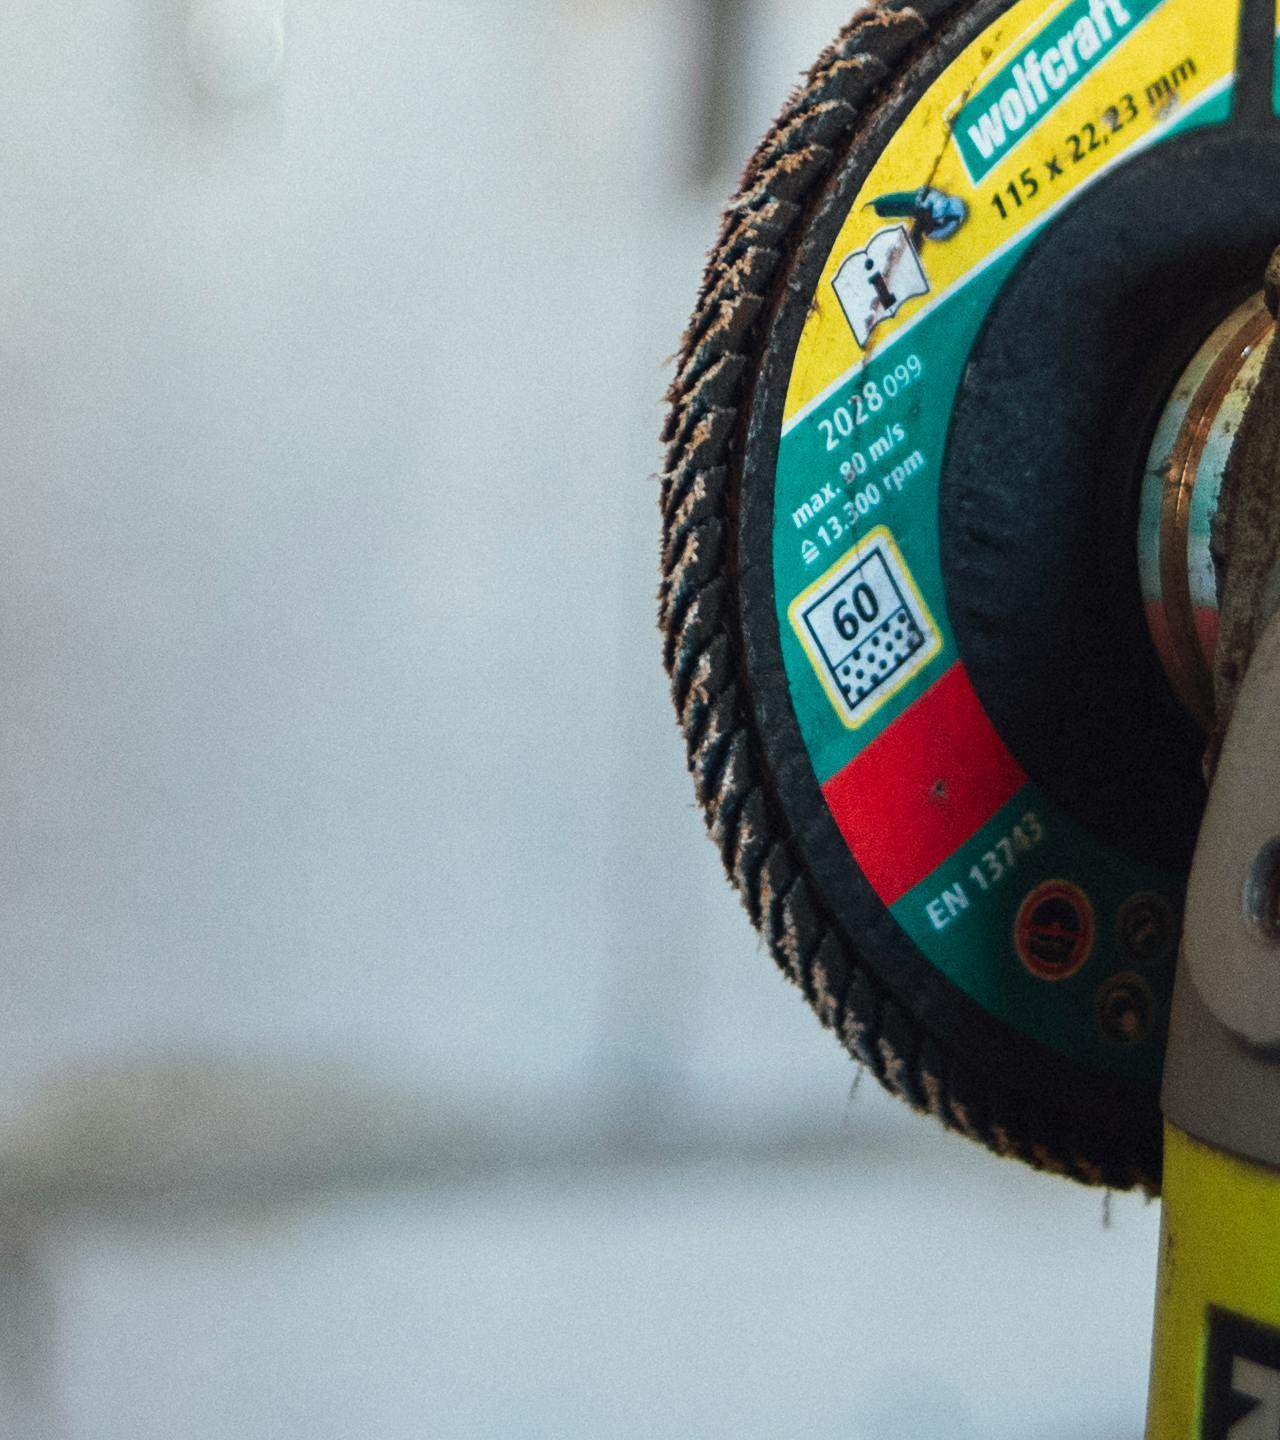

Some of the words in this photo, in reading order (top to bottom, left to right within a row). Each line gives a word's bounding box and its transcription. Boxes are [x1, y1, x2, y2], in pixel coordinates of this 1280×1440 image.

[991, 167, 1039, 220] 115
[1044, 155, 1064, 181] x
[1065, 92, 1139, 164] 22,23
[1144, 57, 1198, 109] mm
[791, 482, 841, 529] max.
[839, 452, 867, 484] 80
[869, 423, 906, 462] m/s
[882, 450, 926, 491] rpm
[832, 582, 879, 641] 60
[925, 882, 969, 930] EN
[970, 812, 1042, 890] 13743
